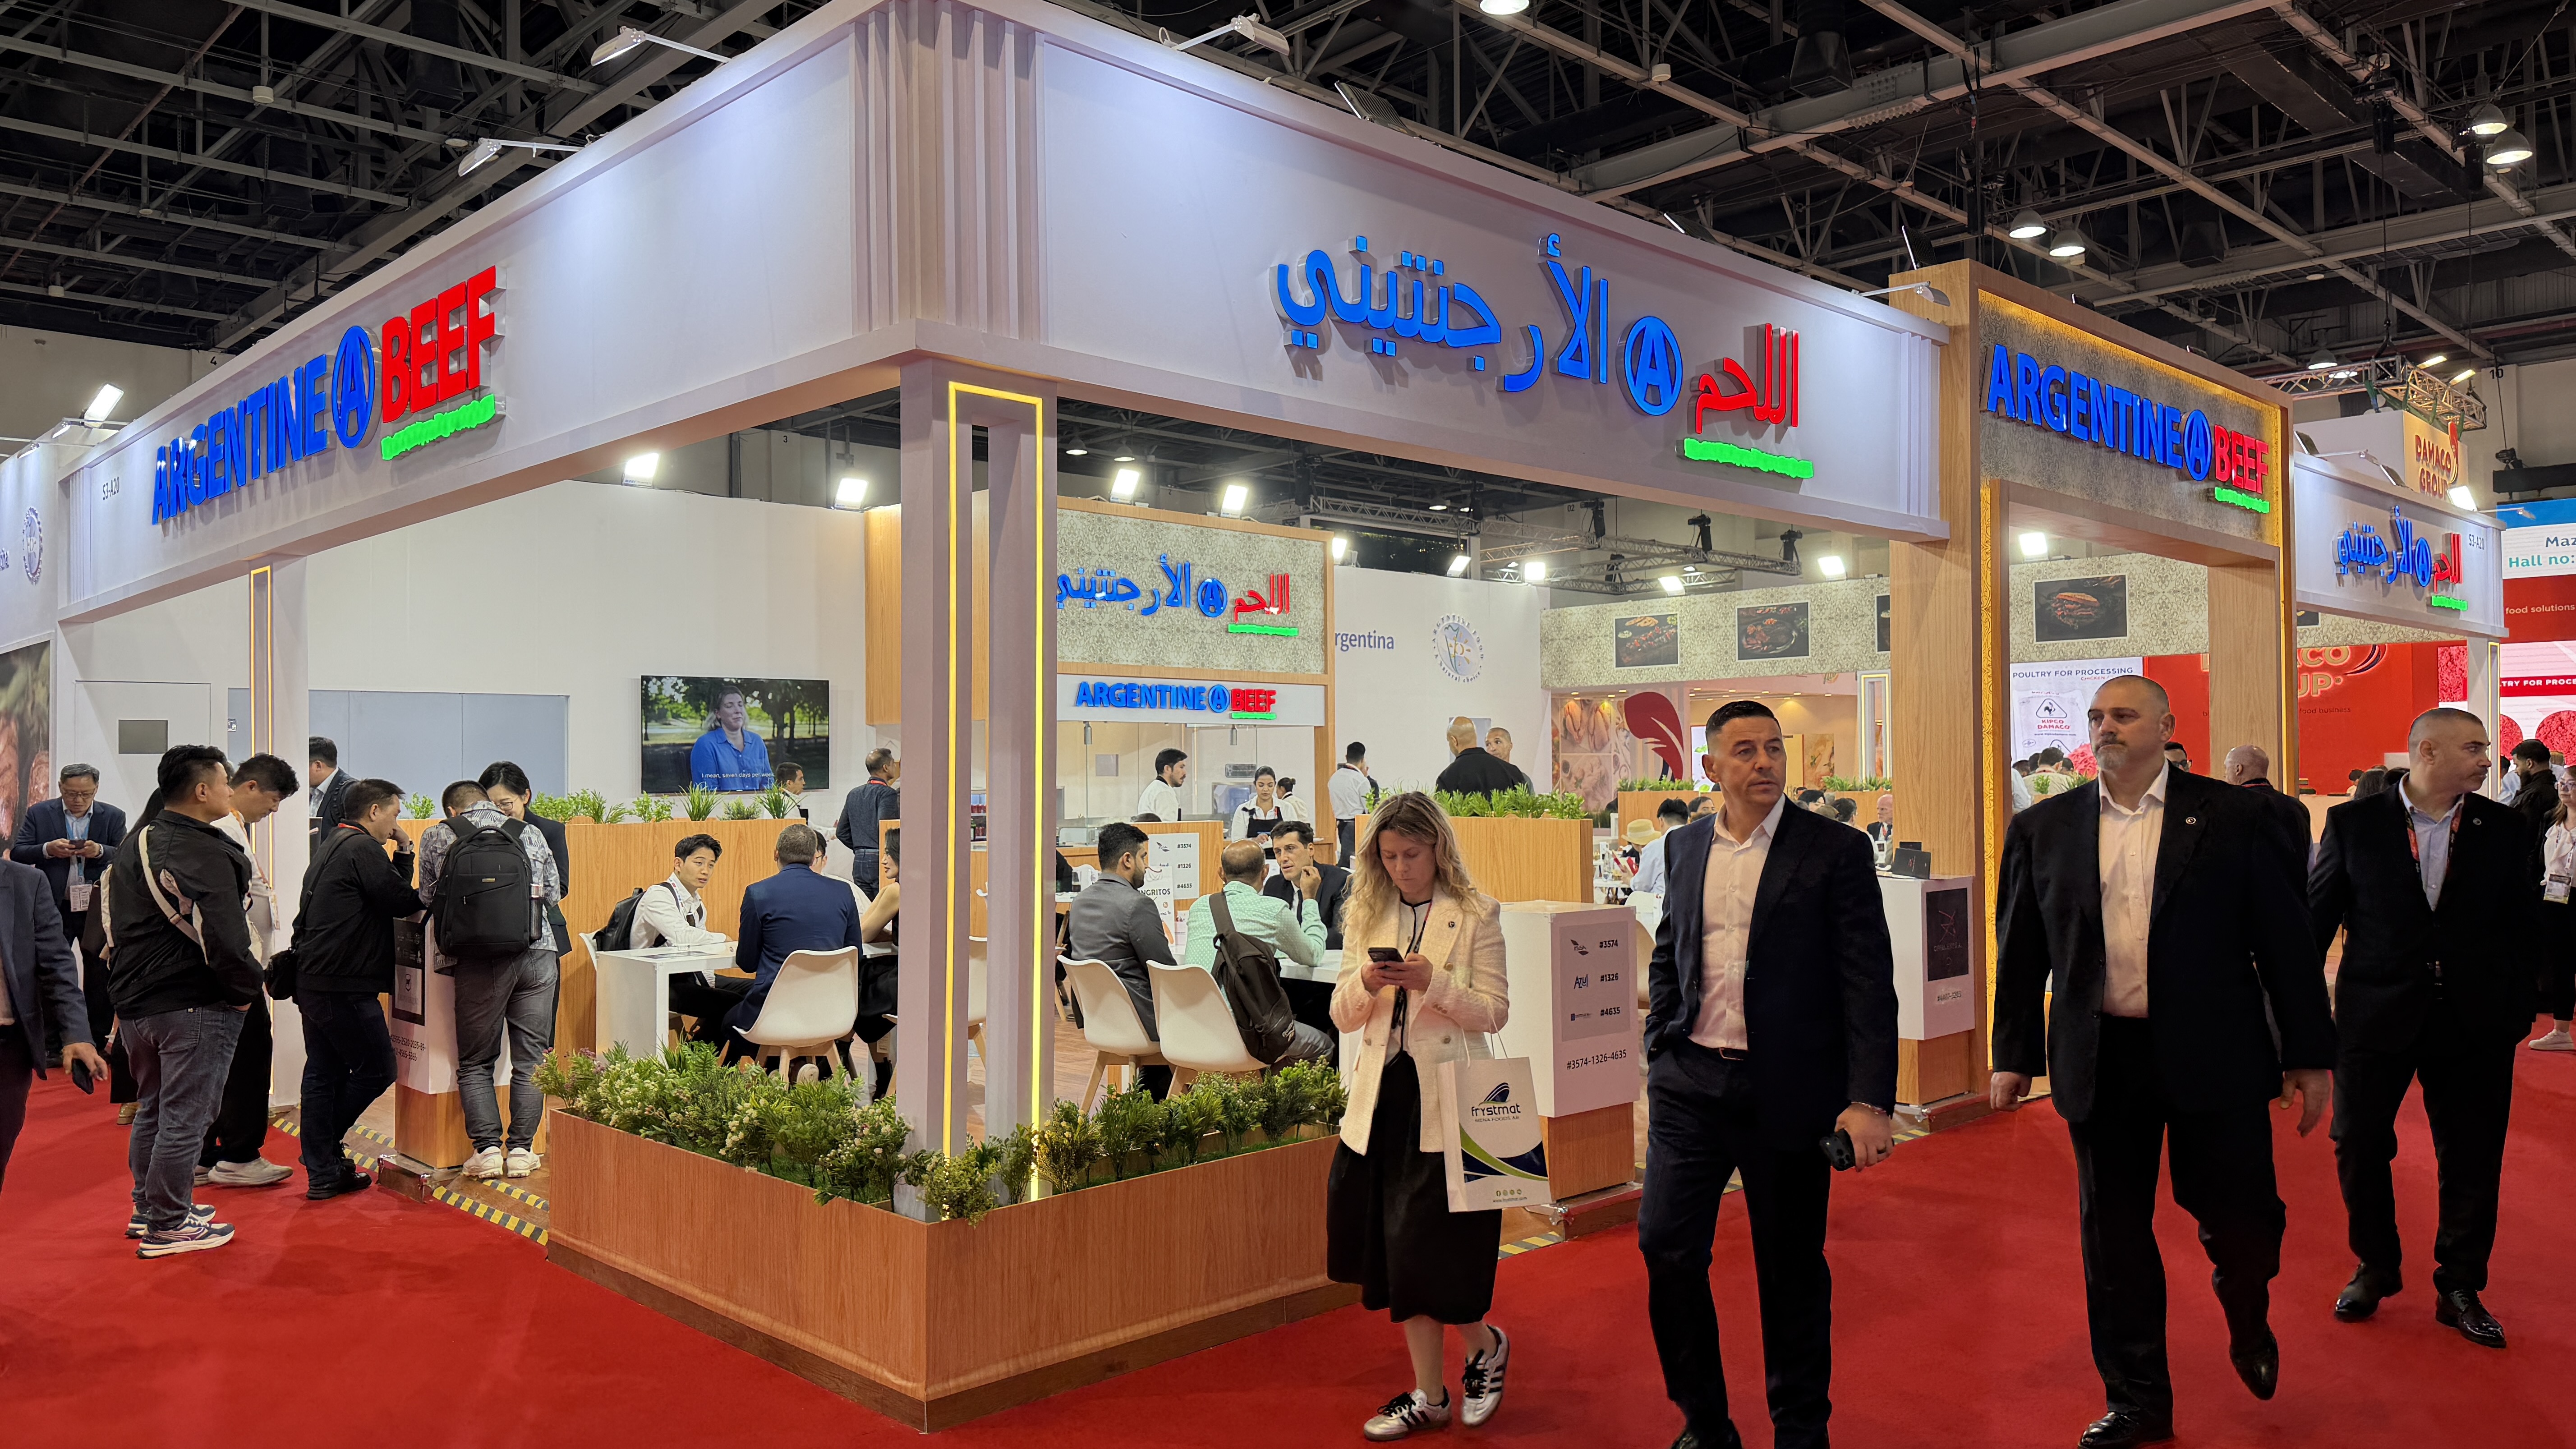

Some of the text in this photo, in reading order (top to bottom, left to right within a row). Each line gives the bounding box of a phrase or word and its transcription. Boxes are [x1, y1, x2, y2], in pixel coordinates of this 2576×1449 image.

[1277, 233, 1608, 393] الأرجنتيني
[1696, 323, 1799, 434] اللحم
[2489, 368, 2504, 379] 10
[152, 354, 327, 524] ARGENTINE
[382, 266, 496, 423] BEEF
[1987, 343, 2184, 469] ARGENTINE
[2214, 424, 2269, 494] BEEF
[2415, 434, 2452, 474] DAMACO
[102, 476, 120, 501] S3-A20
[2337, 505, 2413, 584] الأرجنتيني
[2469, 534, 2485, 550] S3-A20
[2546, 536, 2576, 547] Maz
[2433, 533, 2462, 593] اللحم
[2509, 555, 2575, 568] Hall no:
[1235, 574, 1290, 621] اللحم
[2506, 603, 2575, 615] food solutions
[1335, 630, 1394, 652] rgentina
[2298, 646, 2349, 666] CO
[2075, 667, 2134, 676] PROCESSING
[1076, 681, 1206, 711] ARGENTINE
[1231, 688, 1277, 712] BEEF
[1138, 888, 1171, 896] NGRITOS
[1599, 939, 1618, 948] #3574
[1573, 973, 1619, 989] Azul #1326
[1600, 1007, 1620, 1017] #4635
[1566, 1049, 1627, 1070] #3574-1326-4635
[1471, 1103, 1521, 1117] frystmat
